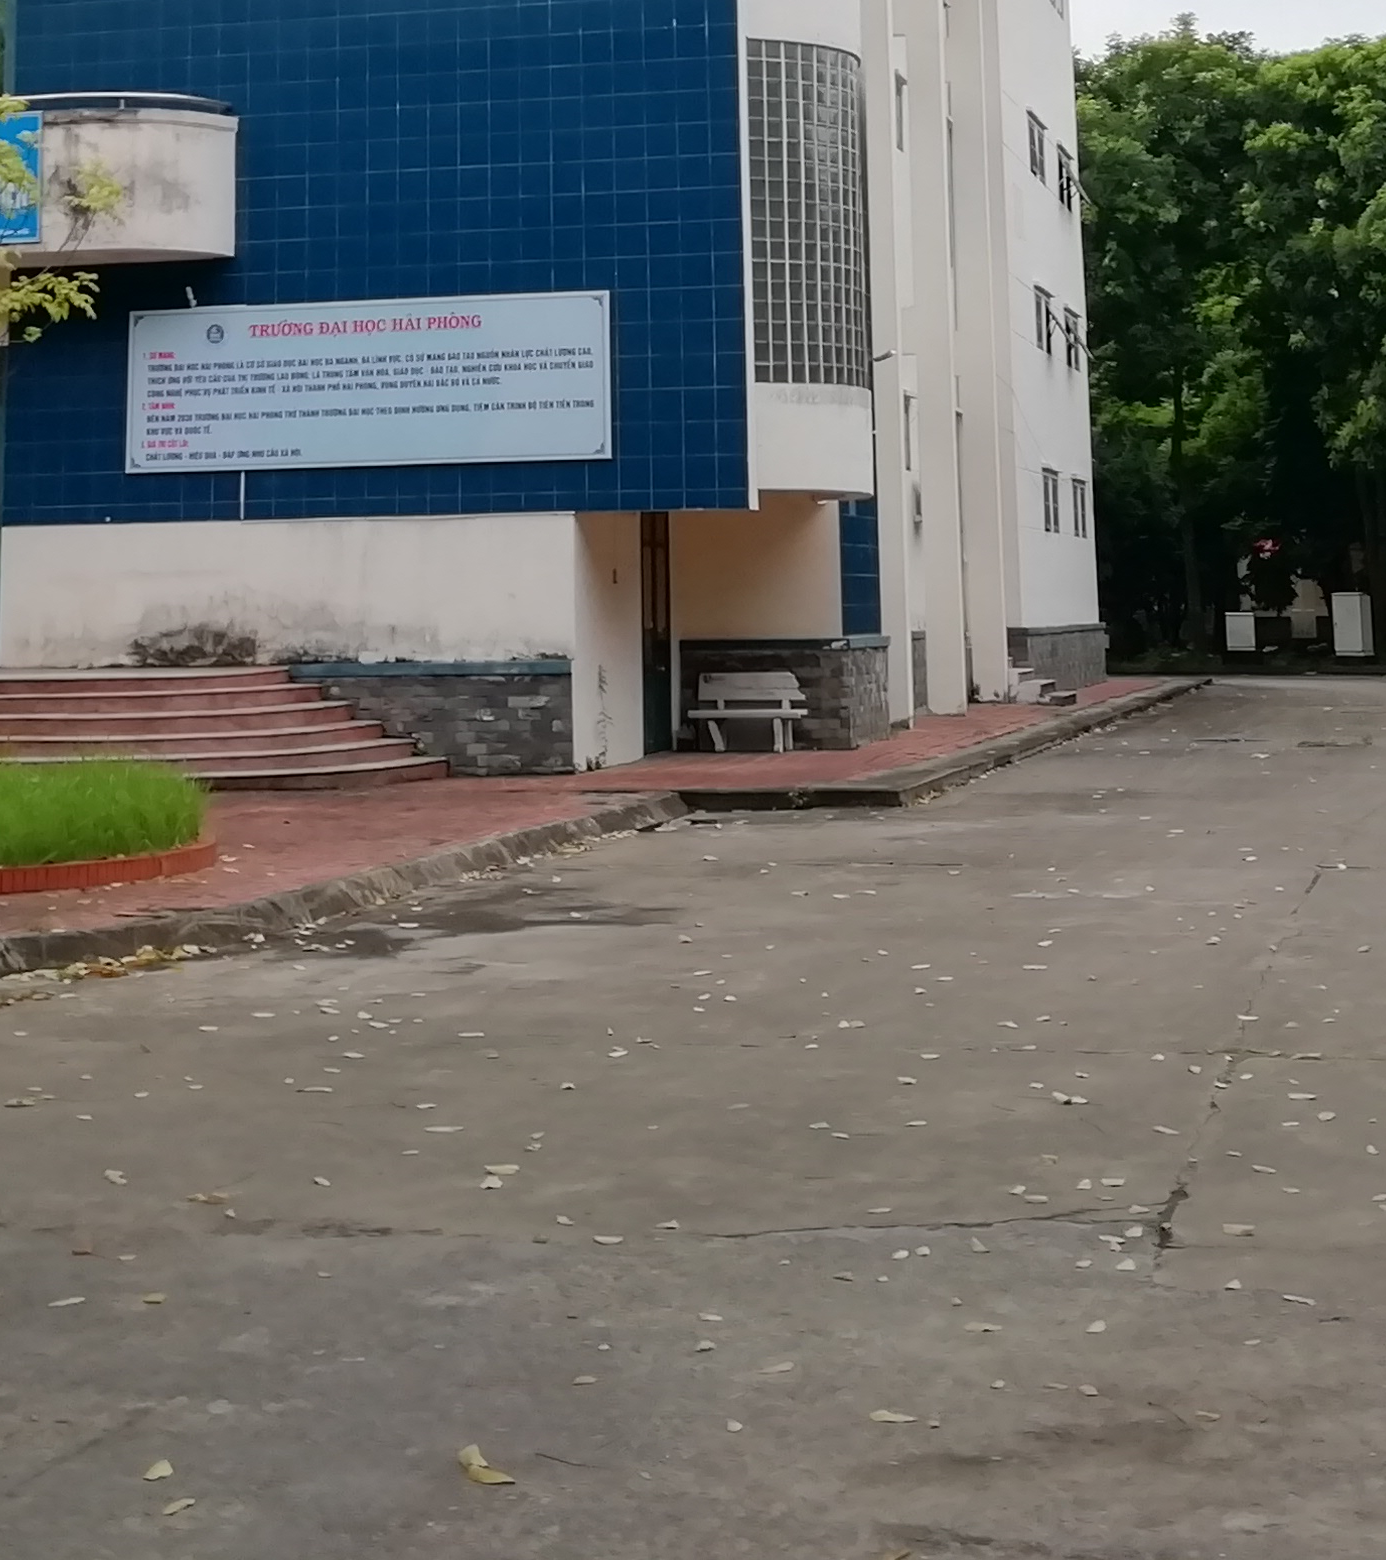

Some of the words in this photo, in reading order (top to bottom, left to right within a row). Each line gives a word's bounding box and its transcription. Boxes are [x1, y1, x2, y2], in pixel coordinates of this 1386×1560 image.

[248, 319, 314, 338] TRƯỜNG
[319, 321, 348, 338] ĐẠI
[353, 318, 386, 336] HỌC
[391, 313, 422, 332] HẢI
[427, 312, 482, 330] PHÒNG
